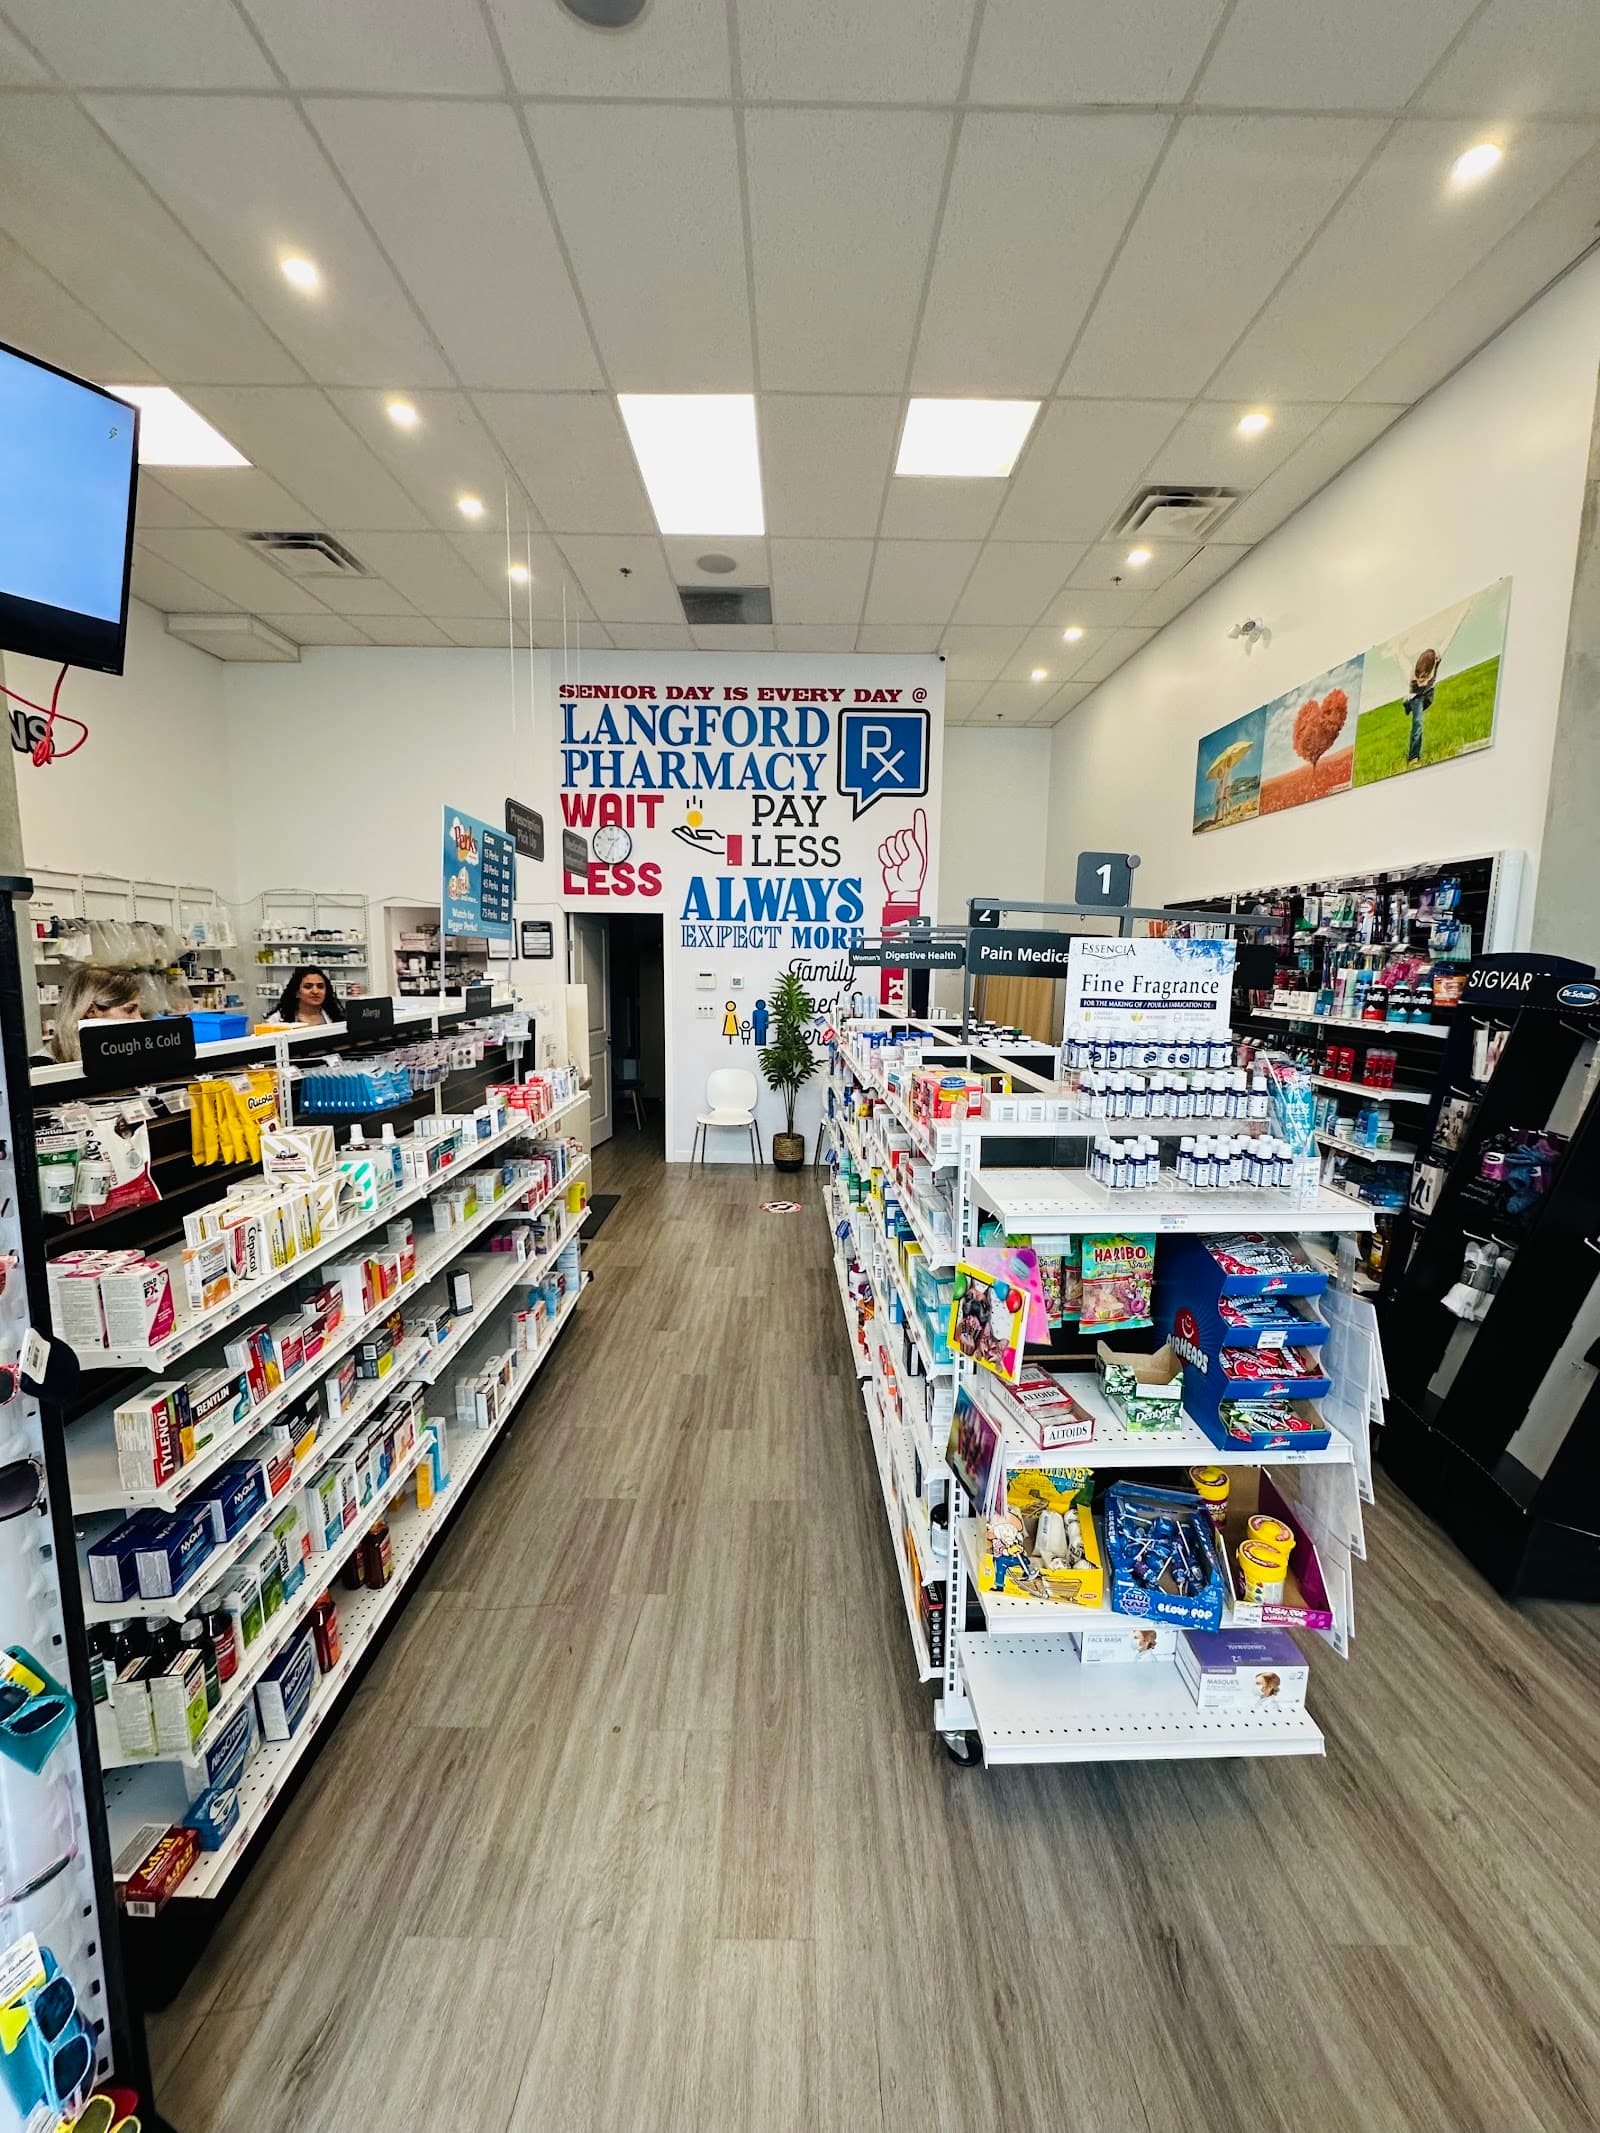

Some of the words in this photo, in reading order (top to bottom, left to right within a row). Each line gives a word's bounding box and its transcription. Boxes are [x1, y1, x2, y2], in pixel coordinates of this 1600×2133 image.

[559, 684, 657, 700] SENIOR
[666, 686, 714, 701] DAY
[724, 687, 748, 701] IS
[757, 687, 845, 702] EVERY
[854, 689, 903, 703] DAY
[911, 688, 928, 703] @
[560, 703, 830, 748] LANGFORD
[560, 750, 827, 791] PHARMACY
[560, 793, 664, 829] WAIT
[751, 794, 827, 827] PAY
[751, 834, 841, 867] LESS
[563, 861, 663, 897] LESS
[1096, 864, 1111, 894] 1
[679, 876, 865, 923] ALWAYS
[979, 909, 992, 922] 2
[681, 925, 782, 949] EXPECT
[792, 926, 865, 950] MORE
[885, 950, 926, 963] Digestive
[927, 950, 957, 962] Health
[980, 946, 1013, 961] Pain
[788, 958, 857, 992] Family
[1080, 973, 1125, 993] Fine
[1132, 975, 1219, 999] Fragrance
[362, 1008, 381, 1019] Allergy
[1083, 999, 1095, 1007] FOR
[1095, 1000, 1108, 1008] THE
[1108, 1000, 1134, 1008] MAKING
[1134, 1000, 1143, 1008] OF
[1168, 1001, 1202, 1009] FABRICATION
[100, 1037, 142, 1056] Cough
[144, 1036, 154, 1050] &
[156, 1032, 181, 1048] Cold
[247, 1093, 274, 1110] Ricola
[246, 1226, 258, 1273] Cepacol
[1094, 1246, 1148, 1262] HARIBO
[143, 1284, 158, 1298] FX
[1166, 1333, 1209, 1375] AIRHEADS
[195, 1386, 230, 1417] BENYLIN
[1022, 1389, 1060, 1403] ALTOIDS
[1135, 1403, 1175, 1422] Dentyne
[157, 1406, 175, 1477] TYLENOL
[1049, 1424, 1089, 1442] ALTOIDS
[234, 1478, 256, 1505] NyQuil
[180, 1522, 205, 1553] NyQuil
[1157, 1602, 1189, 1616] BLOW
[1190, 1608, 1213, 1620] POP
[1206, 1678, 1239, 1686] MASQUES
[140, 1837, 175, 1880] Advil
